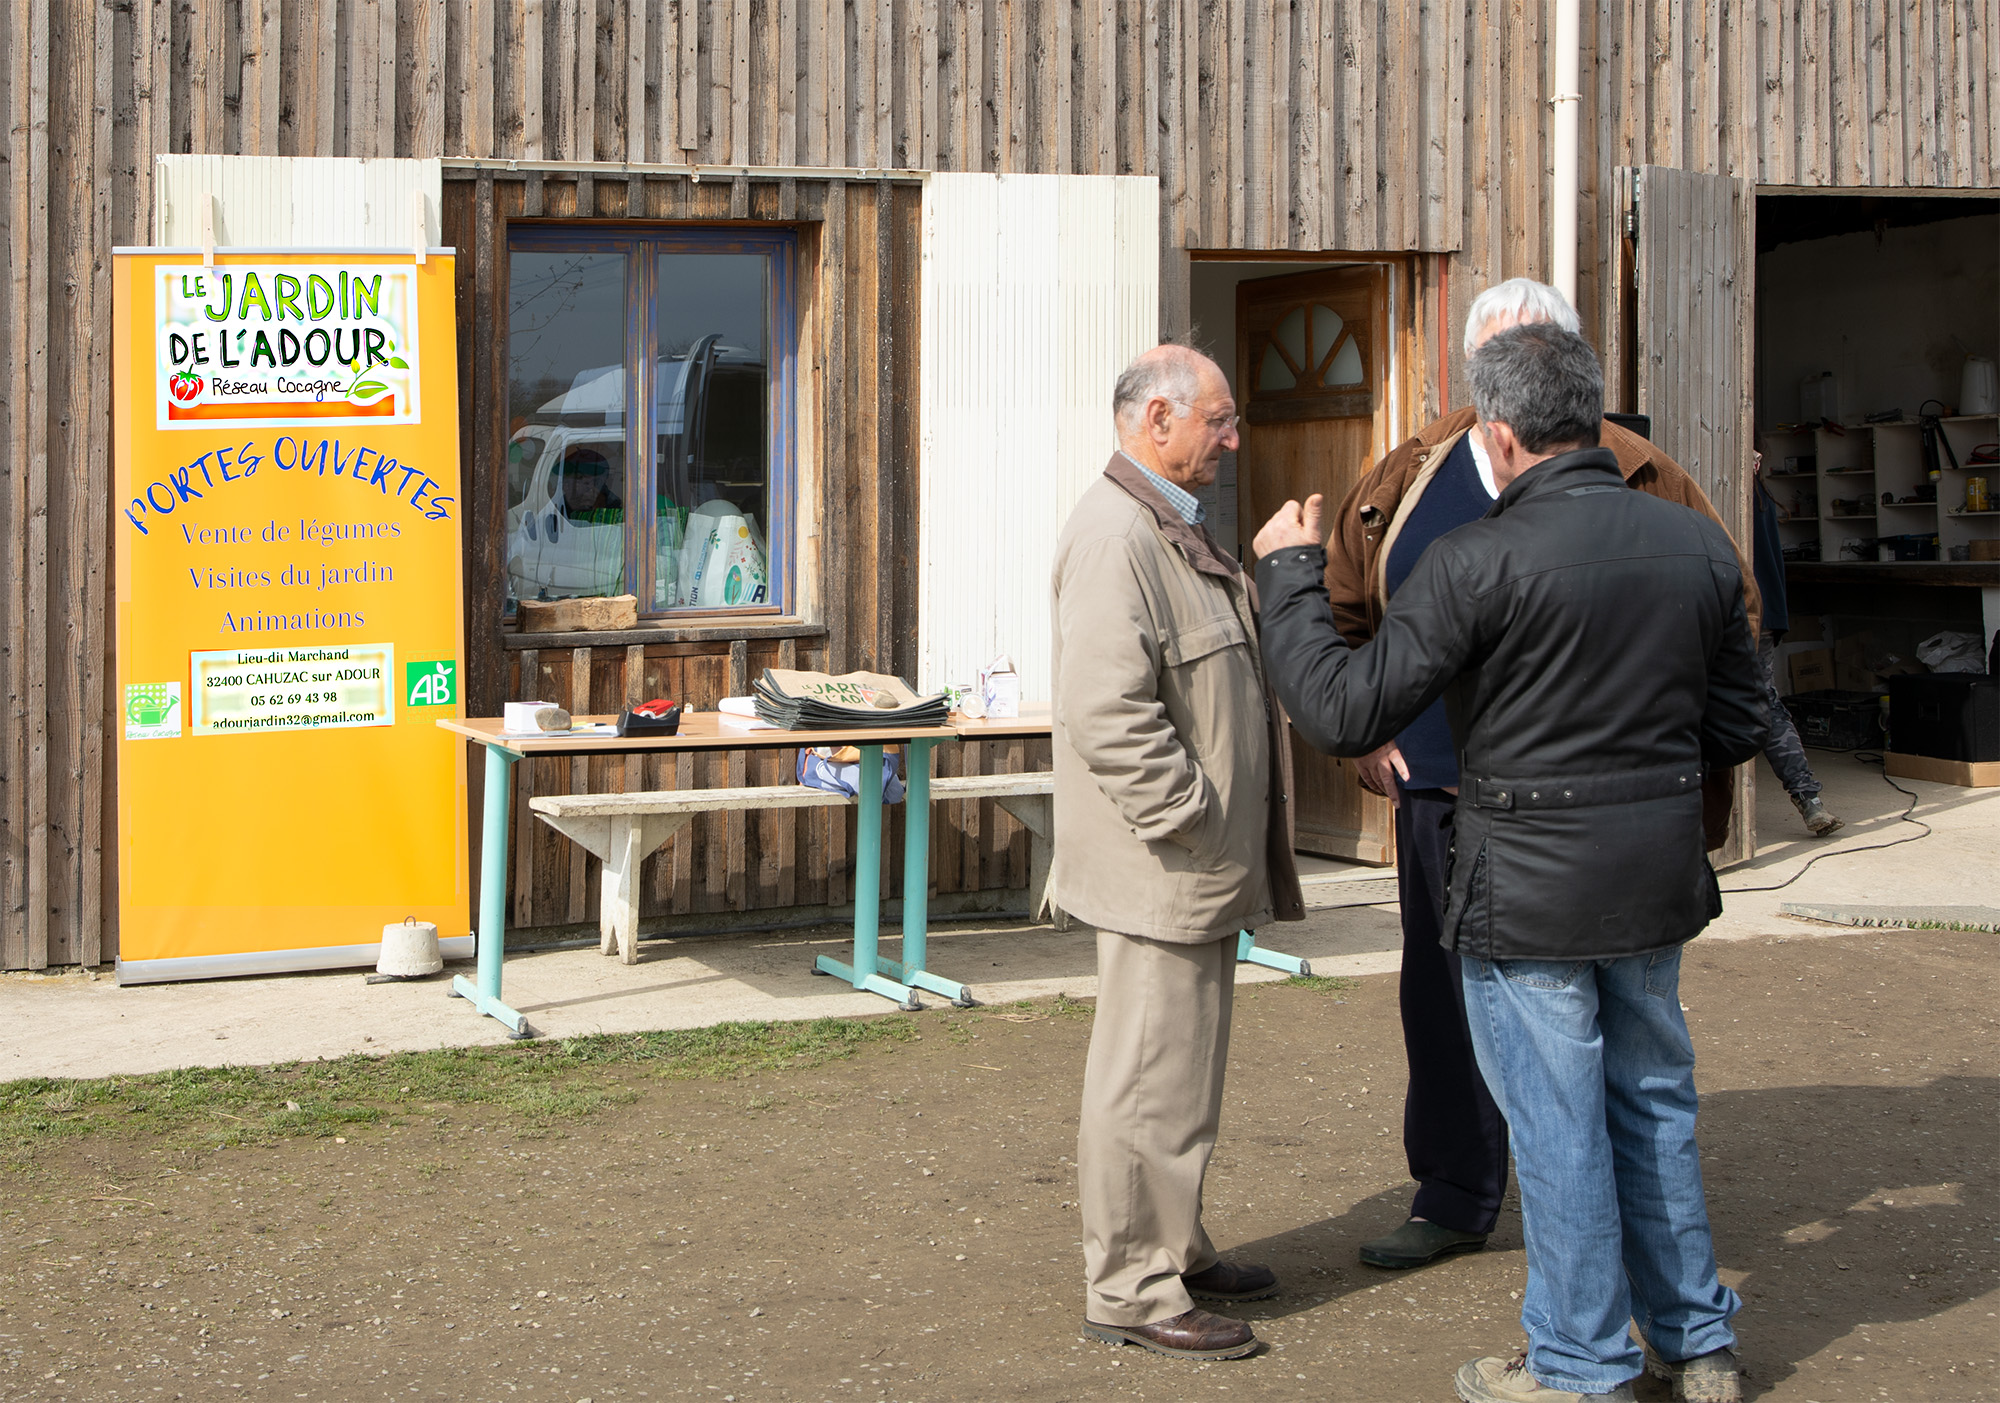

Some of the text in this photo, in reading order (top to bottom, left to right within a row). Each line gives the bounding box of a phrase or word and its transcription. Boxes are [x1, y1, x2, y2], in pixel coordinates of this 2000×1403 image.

[182, 271, 382, 322] LE JARDIN
[169, 328, 390, 368] DE L'ADOUR
[212, 376, 348, 402] Réseau Cocagne
[125, 436, 455, 535] PORTES OUVERTES
[181, 518, 401, 547] Vente de légumes
[189, 561, 394, 592] Visites du jardin
[219, 608, 365, 634] Animations
[237, 648, 350, 665] Lieu-dit Marchand
[206, 668, 380, 688] 32400 CAHUZAC sur ADOUR
[409, 673, 451, 706] AB
[250, 691, 338, 706] 05 62 69 43 98
[213, 711, 375, 730] adourjardin32@gmail.com
